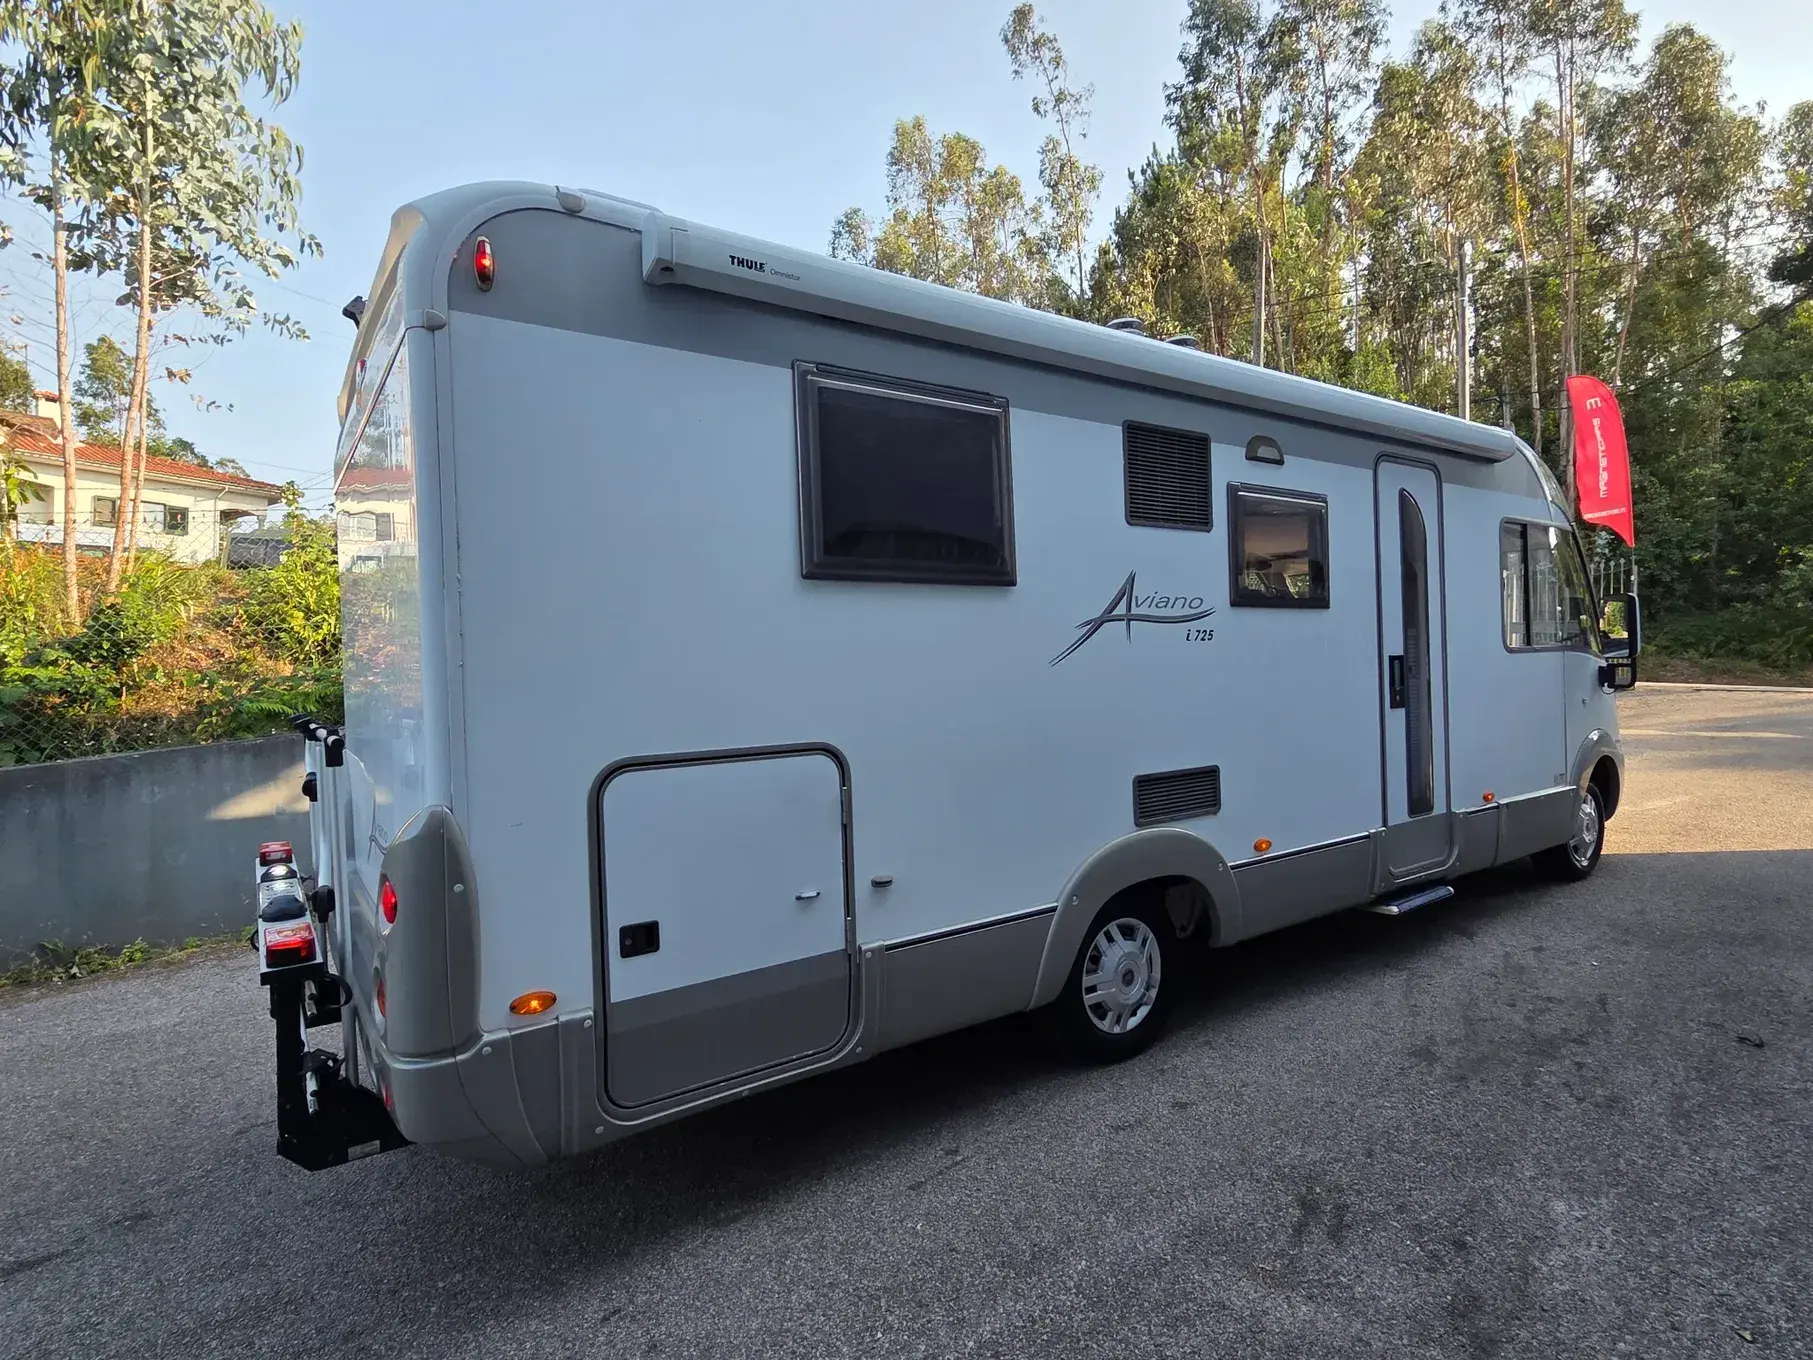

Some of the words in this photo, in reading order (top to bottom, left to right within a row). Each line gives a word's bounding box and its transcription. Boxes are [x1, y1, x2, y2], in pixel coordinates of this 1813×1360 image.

[729, 255, 765, 273] THULE
[1048, 569, 1216, 667] Aviano
[1185, 628, 1192, 642] i
[1194, 629, 1214, 642] 725
